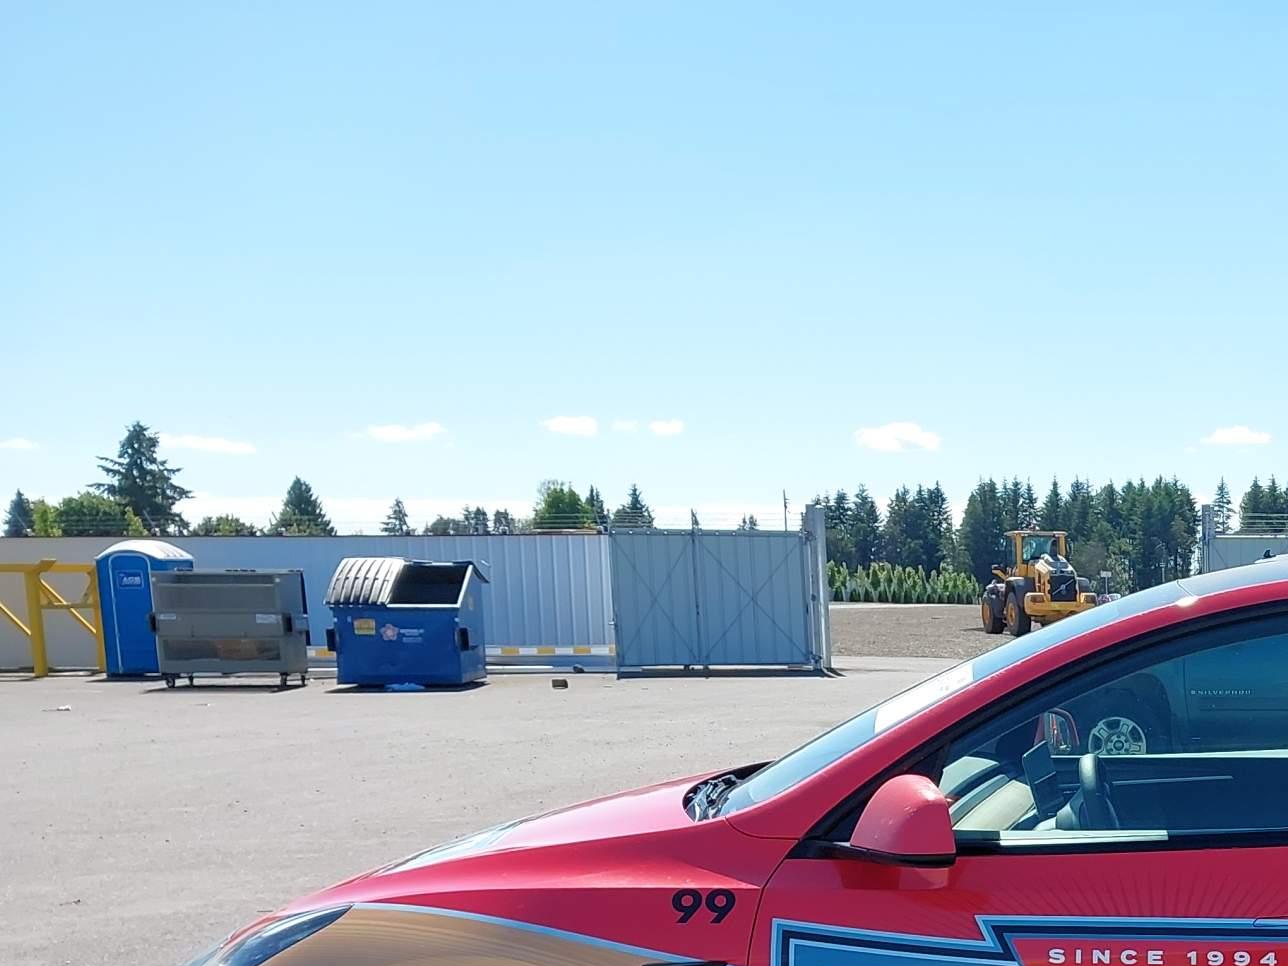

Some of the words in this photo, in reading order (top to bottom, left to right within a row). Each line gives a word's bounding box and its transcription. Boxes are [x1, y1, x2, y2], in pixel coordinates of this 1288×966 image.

[671, 888, 736, 924] 99
[1048, 948, 1164, 965] SINCE
[1186, 951, 1278, 966] 1994
